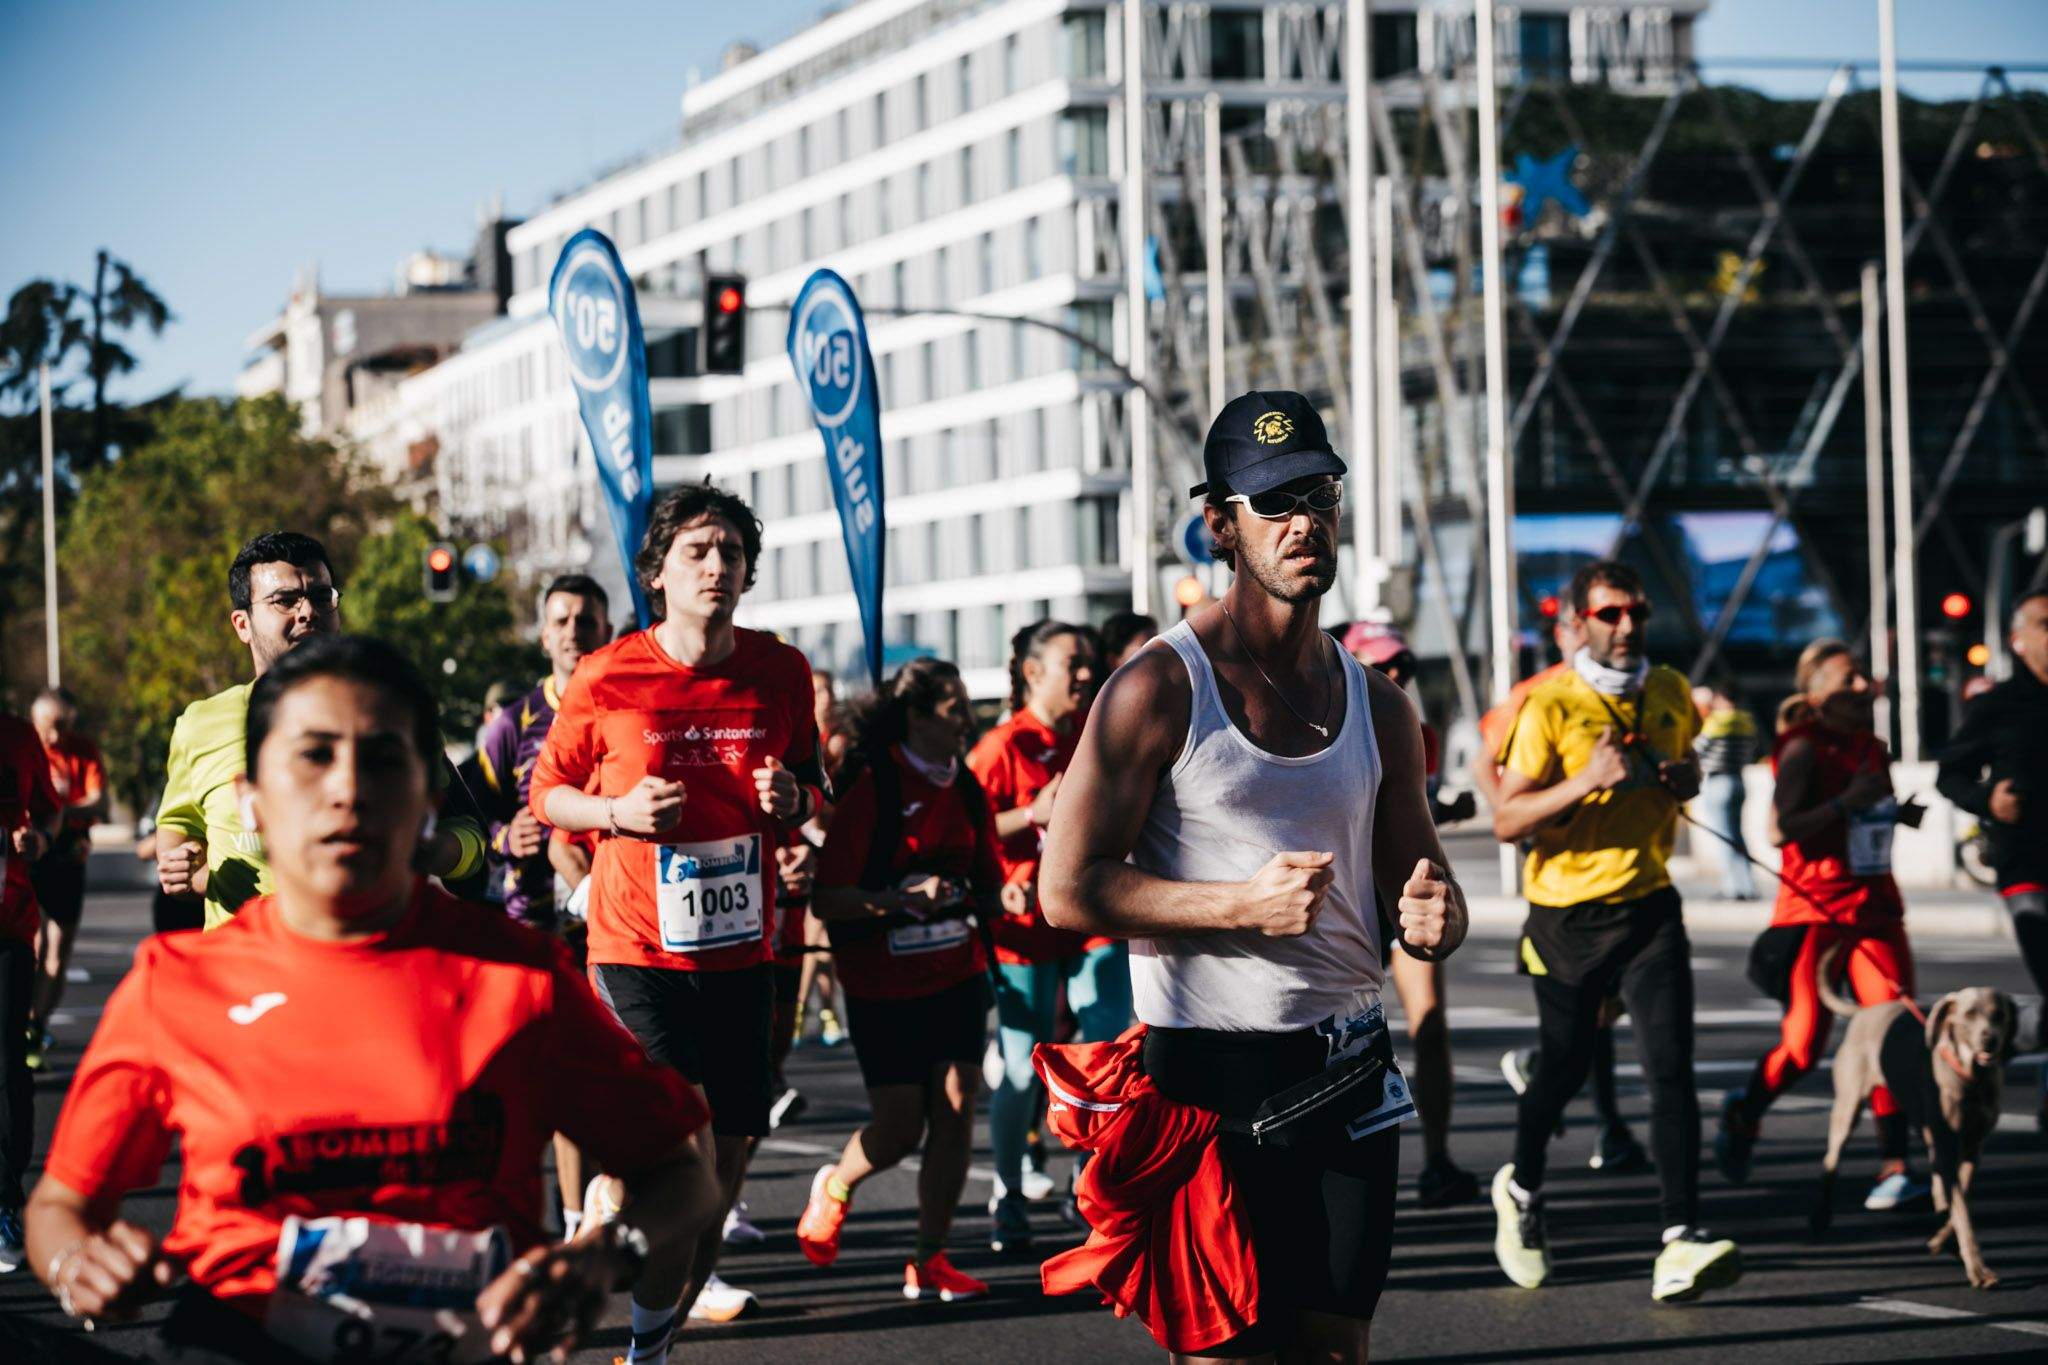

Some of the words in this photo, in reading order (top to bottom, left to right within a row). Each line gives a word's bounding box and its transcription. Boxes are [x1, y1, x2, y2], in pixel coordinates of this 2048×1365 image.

[642, 729, 684, 746] Sports
[703, 726, 767, 740] Santander
[682, 882, 750, 917] 1003
